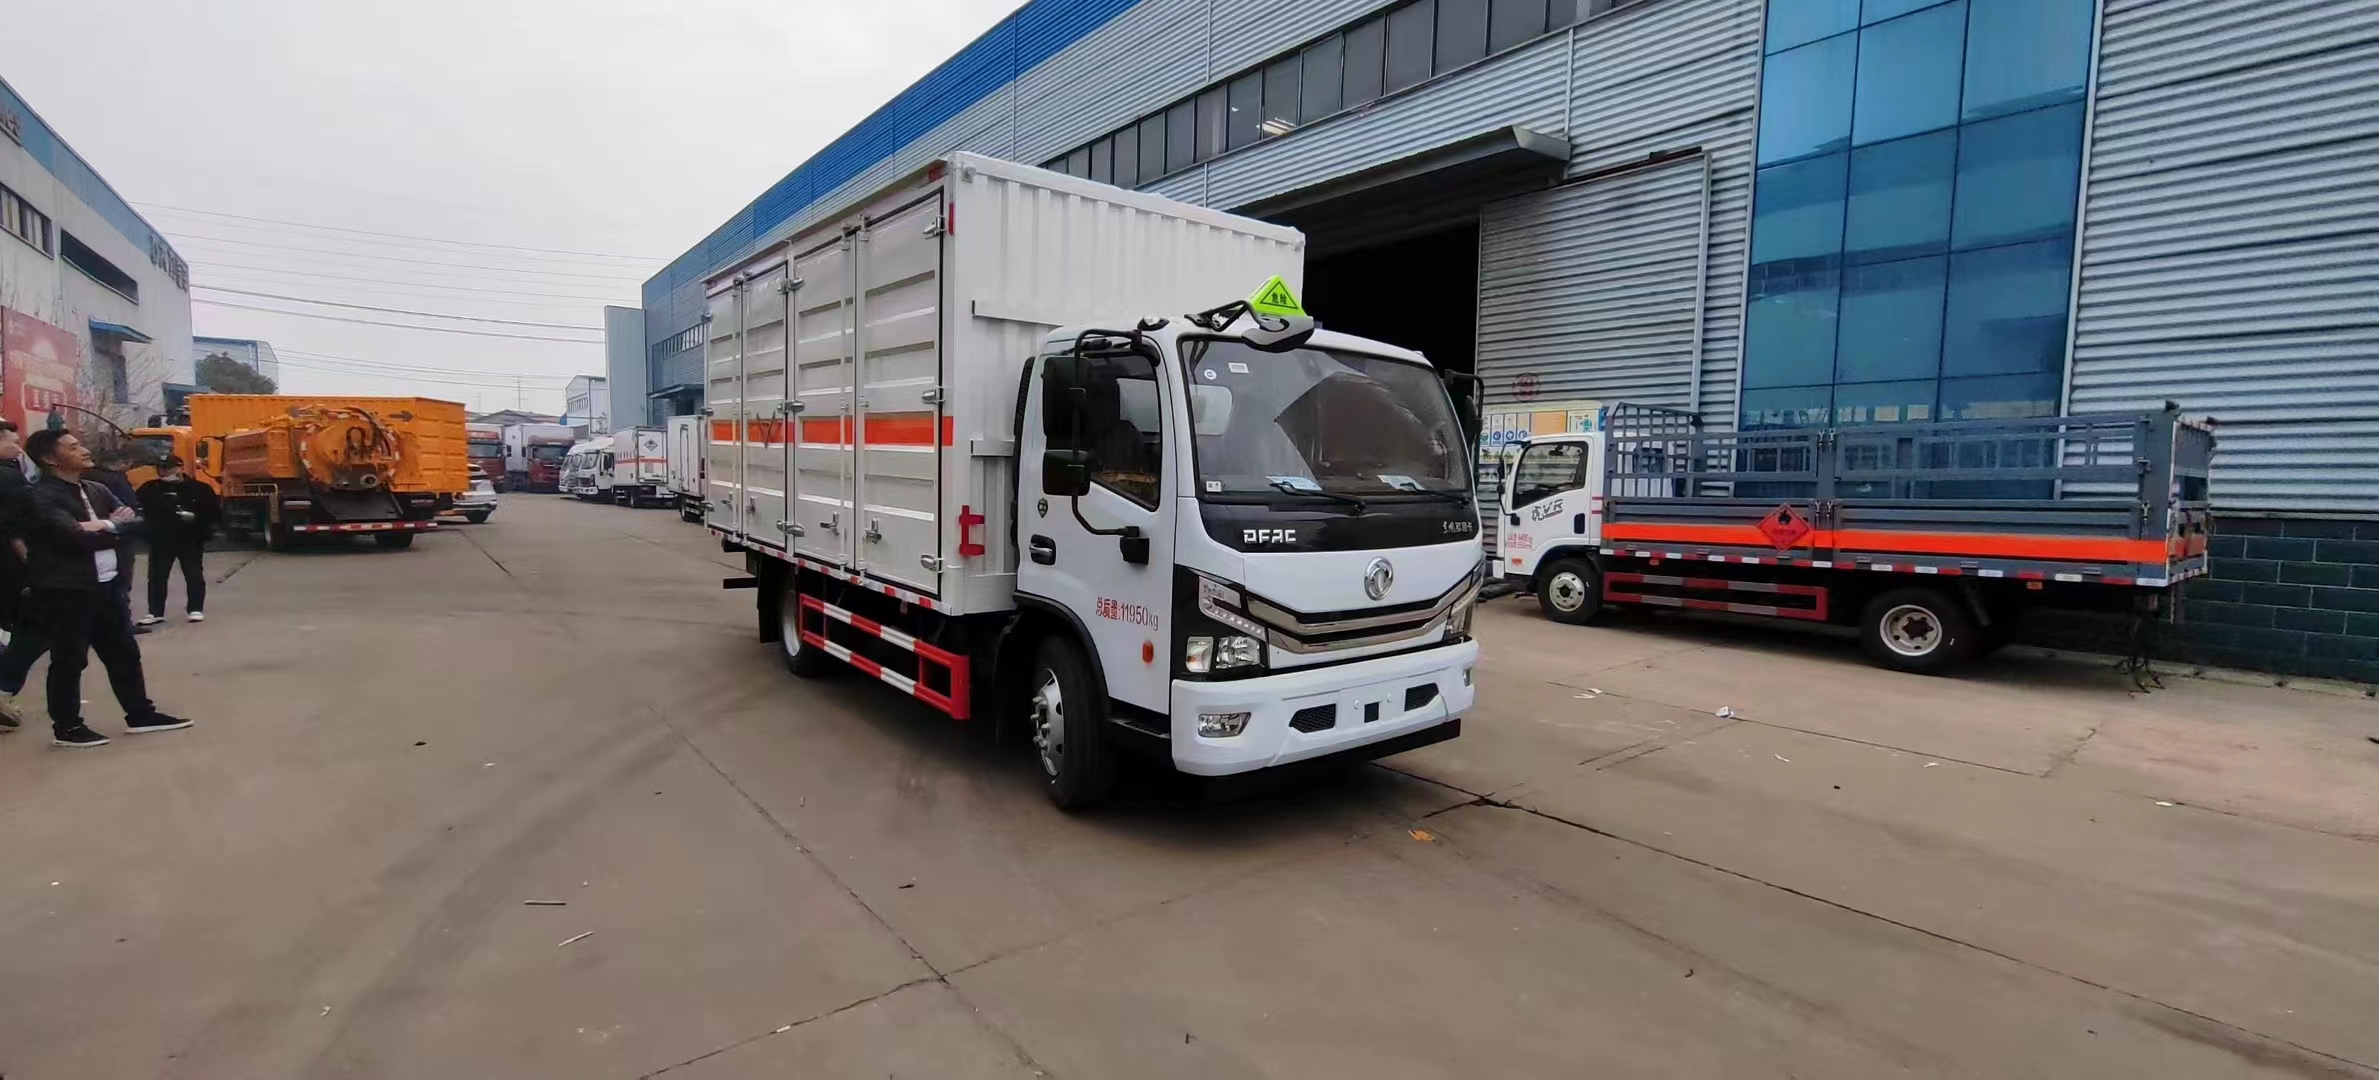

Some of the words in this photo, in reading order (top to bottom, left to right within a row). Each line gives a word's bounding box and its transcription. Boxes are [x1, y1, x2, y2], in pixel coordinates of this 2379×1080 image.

[1272, 292, 1287, 305] 危险
[1243, 529, 1297, 543] DFAC
[1096, 597, 1159, 631] 总质量:11950kg
